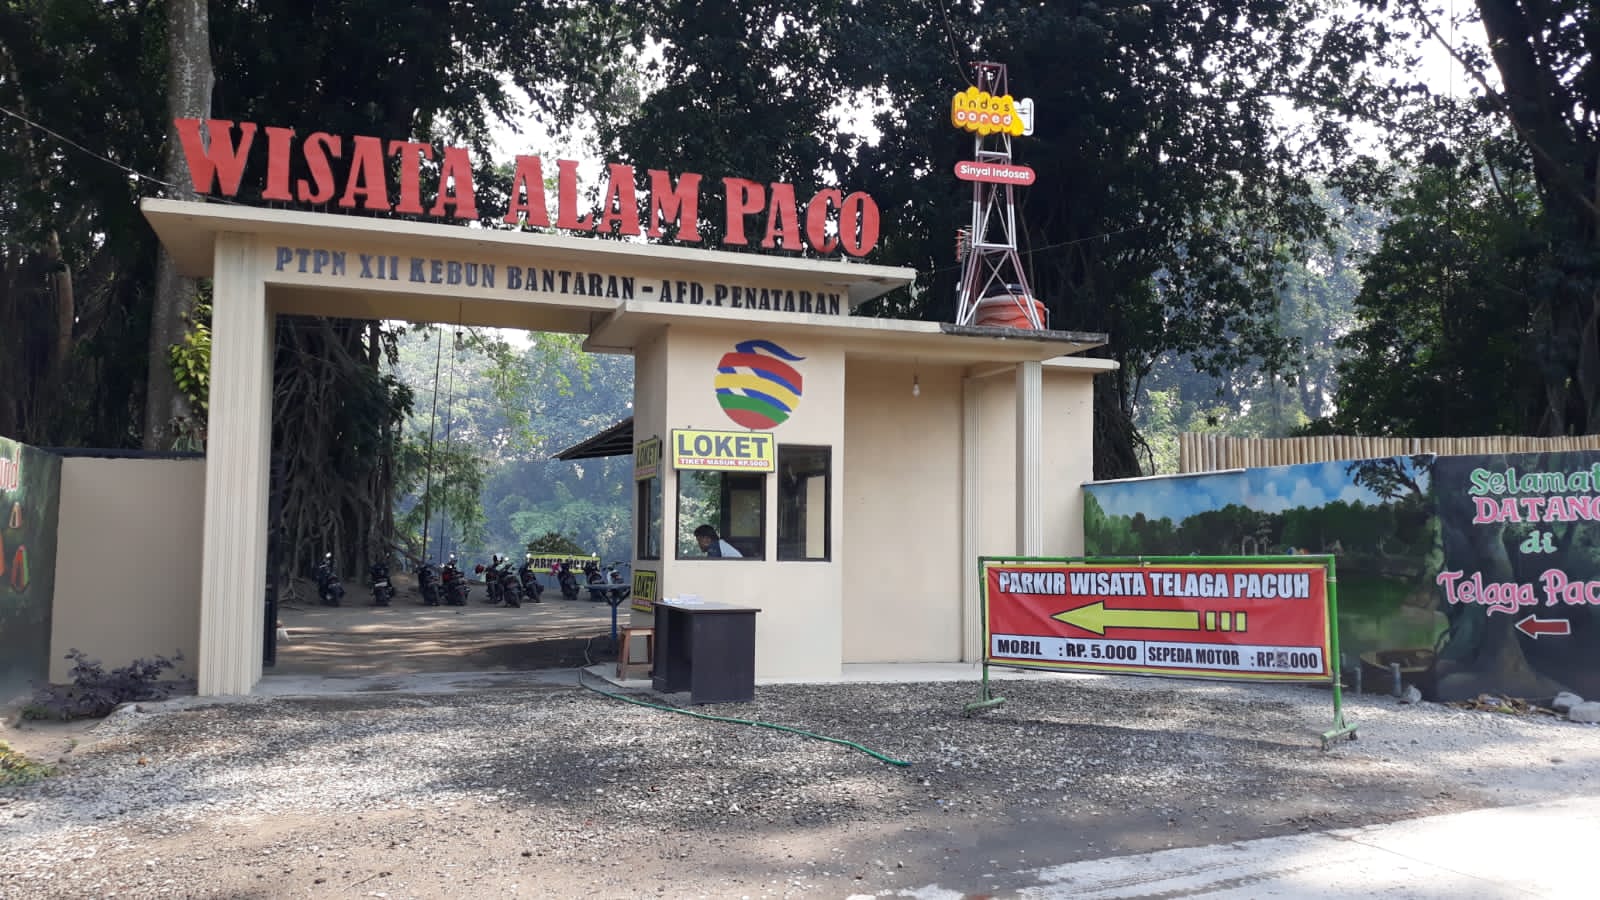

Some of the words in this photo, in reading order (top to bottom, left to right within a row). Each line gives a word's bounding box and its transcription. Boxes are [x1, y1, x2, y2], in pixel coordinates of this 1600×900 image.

[960, 164, 990, 177] Sinyal
[993, 166, 1031, 180] Indosat
[175, 118, 479, 220] WISATA
[504, 155, 703, 242] ALAM
[722, 177, 880, 257] PACO
[275, 246, 347, 276] PTPN
[359, 253, 400, 281] XII
[409, 257, 496, 290] KEBUN
[507, 266, 636, 300] BANTARAN
[678, 434, 768, 459] LOKET
[1520, 530, 1558, 554] di
[998, 571, 1066, 595] PARKIR
[1069, 572, 1147, 597] WISATA
[1148, 572, 1230, 598] TELAGA
[1233, 573, 1310, 600] PACUH
[1436, 569, 1539, 617] Telaga
[998, 639, 1042, 656] MOBIL
[1091, 644, 1137, 660] 5.000
[1148, 646, 1193, 664] SEPEDA
[1195, 648, 1240, 666] MOTOR
